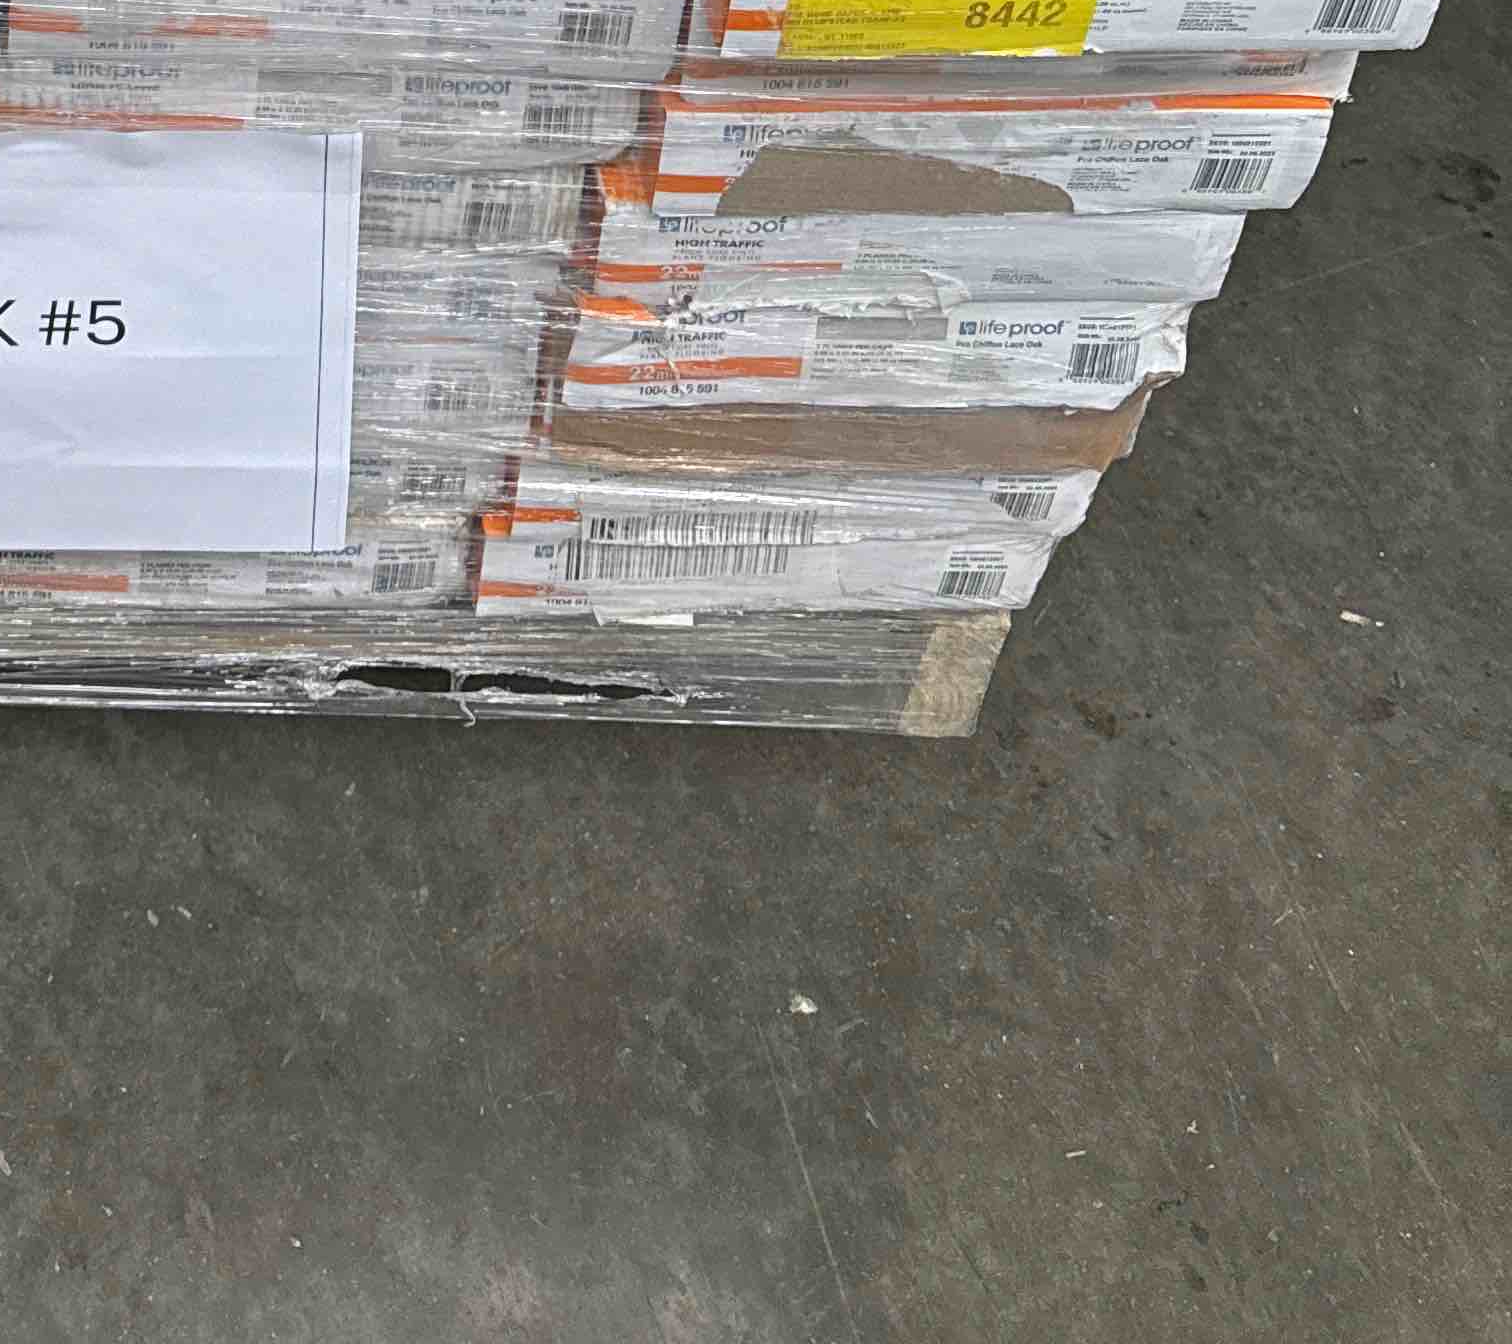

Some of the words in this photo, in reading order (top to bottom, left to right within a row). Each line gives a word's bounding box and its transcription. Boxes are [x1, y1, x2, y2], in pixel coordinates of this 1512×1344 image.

[963, 0, 1070, 31] 8442
[38, 298, 128, 348] #5
[978, 318, 1066, 337] lifeproof
